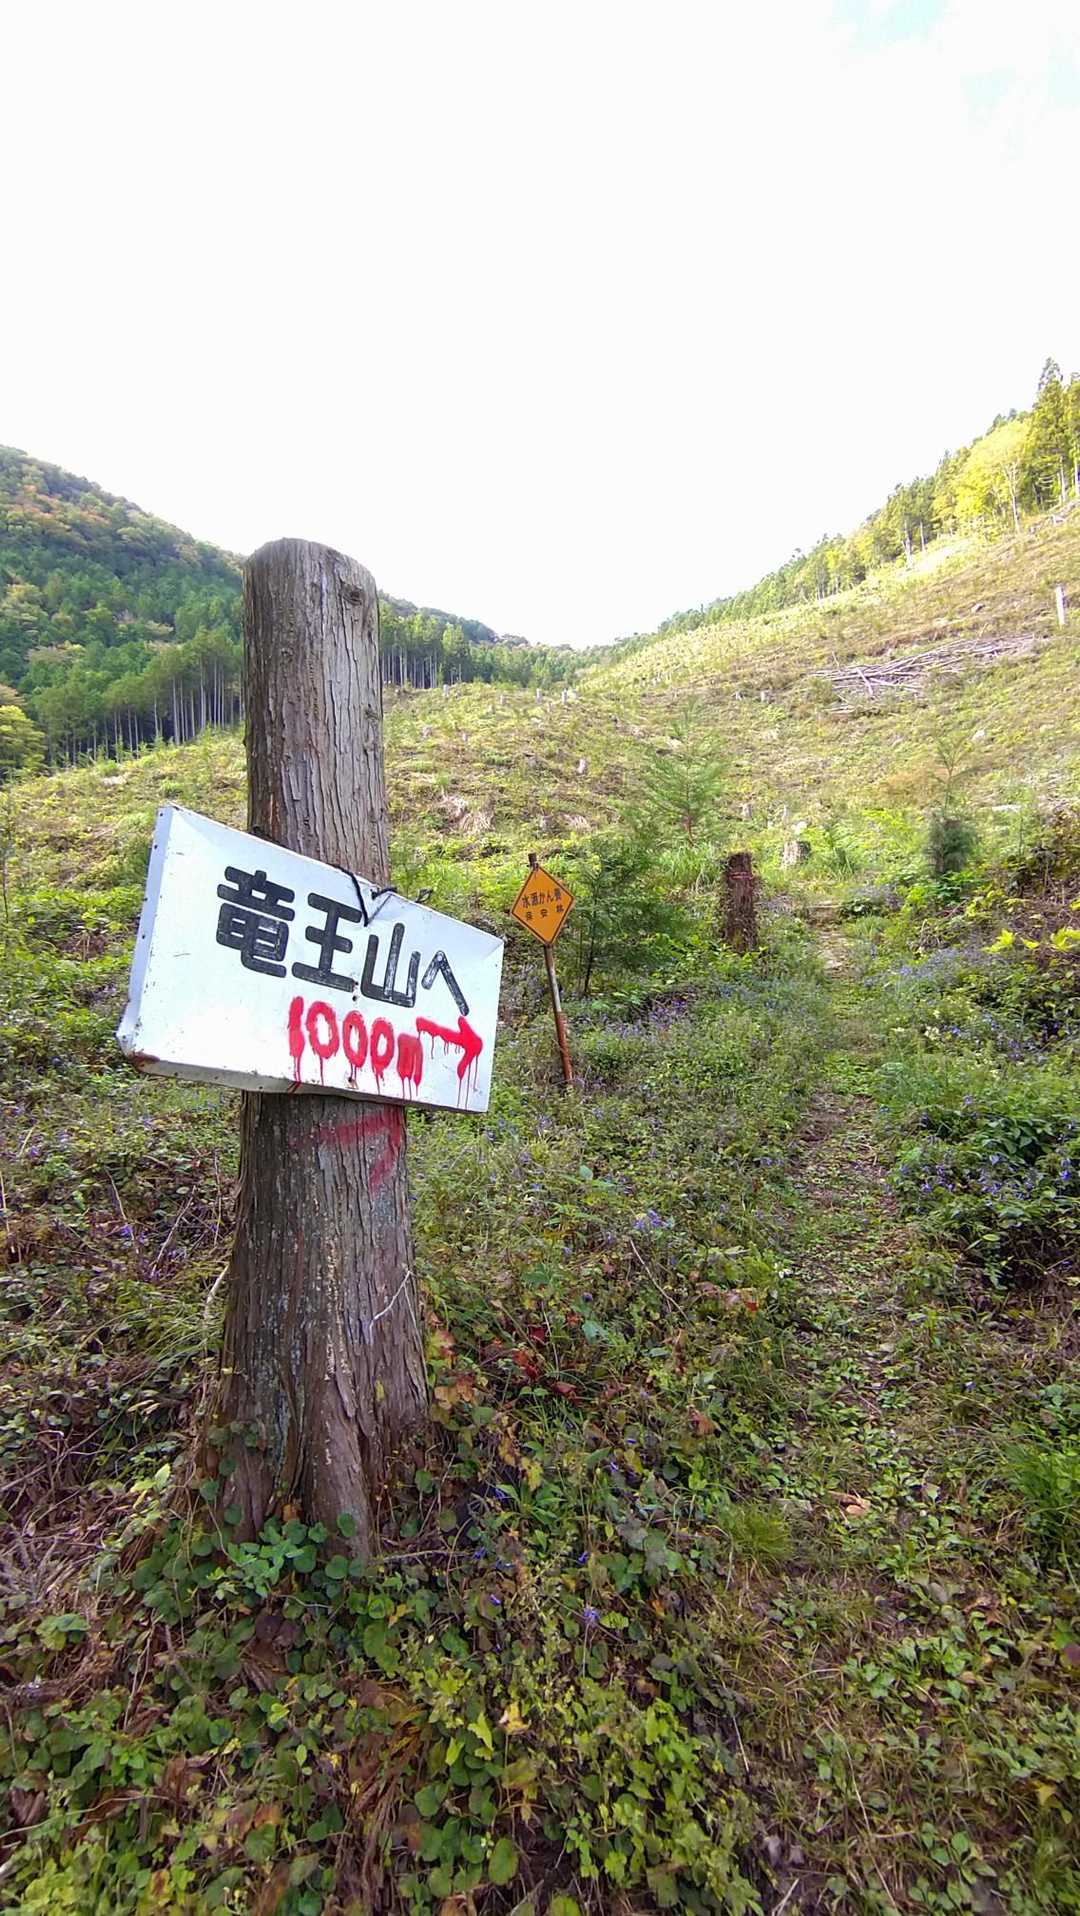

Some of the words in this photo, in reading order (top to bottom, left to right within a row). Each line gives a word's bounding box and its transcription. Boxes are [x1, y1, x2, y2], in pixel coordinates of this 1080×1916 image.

[216, 865, 469, 1016] 竜王山へ
[287, 995, 424, 1087] 1000m
